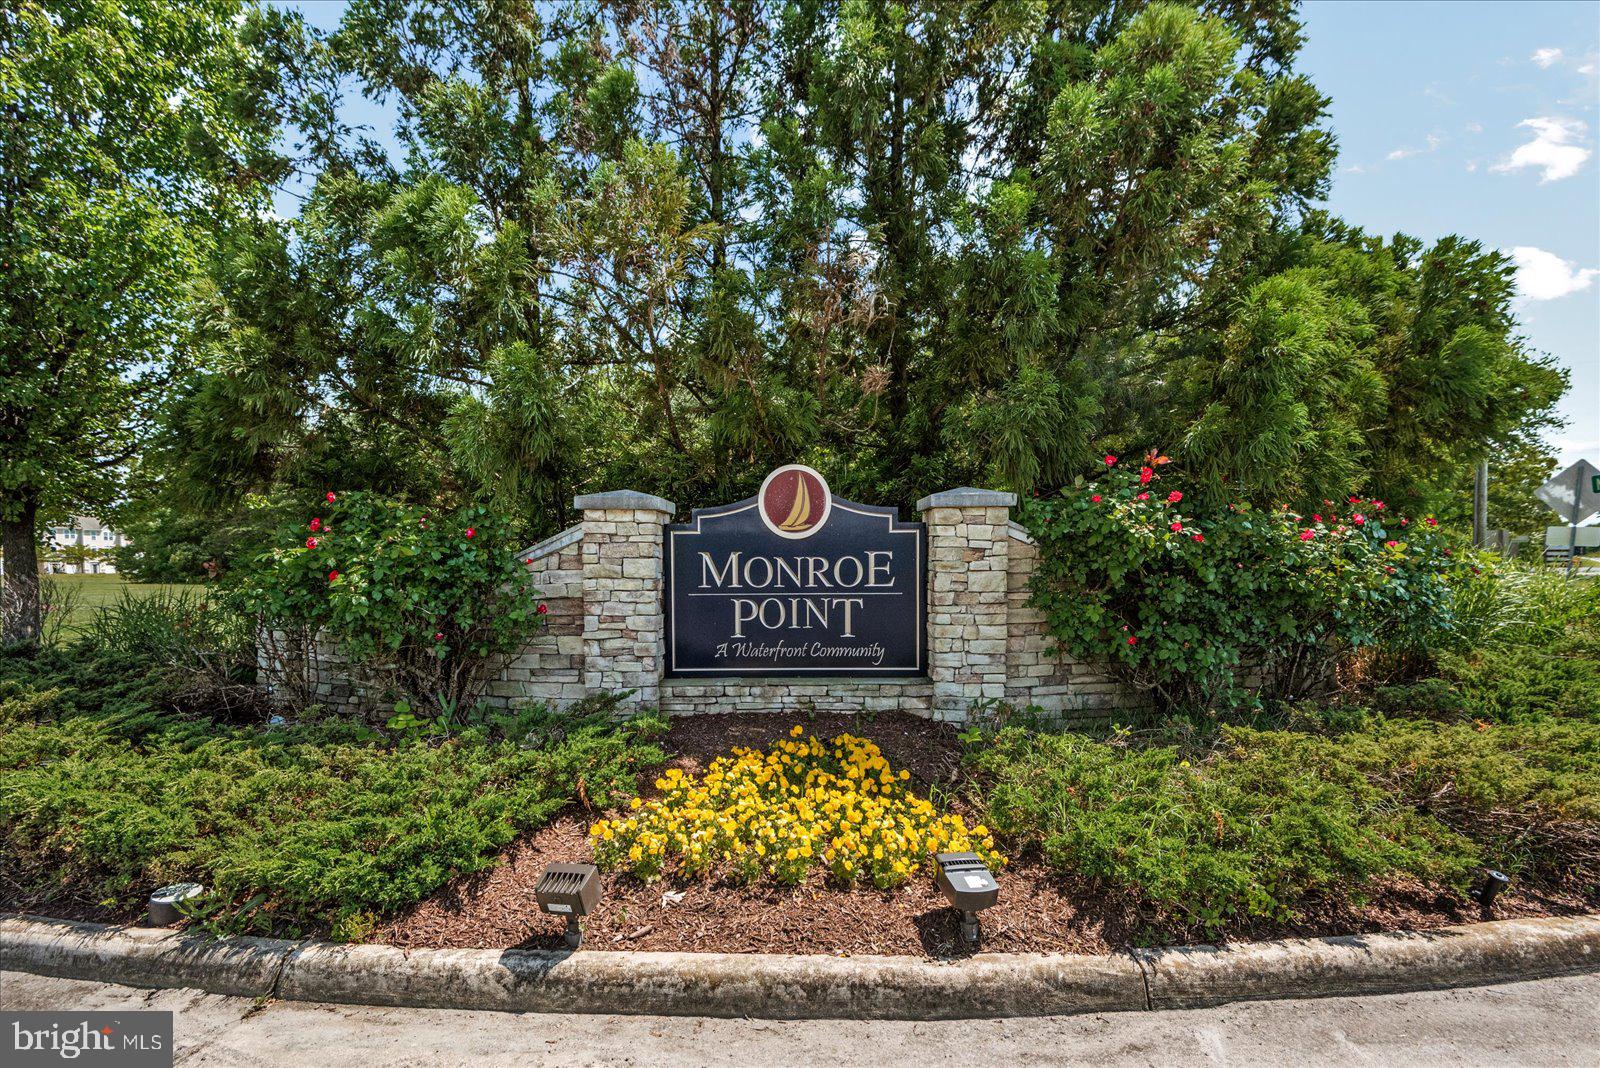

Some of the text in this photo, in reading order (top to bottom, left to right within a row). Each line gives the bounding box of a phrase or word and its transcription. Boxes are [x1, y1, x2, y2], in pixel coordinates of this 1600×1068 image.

[698, 551, 895, 588] MONROE
[730, 597, 864, 638] POINT
[715, 640, 885, 665] A Waterfront Community
